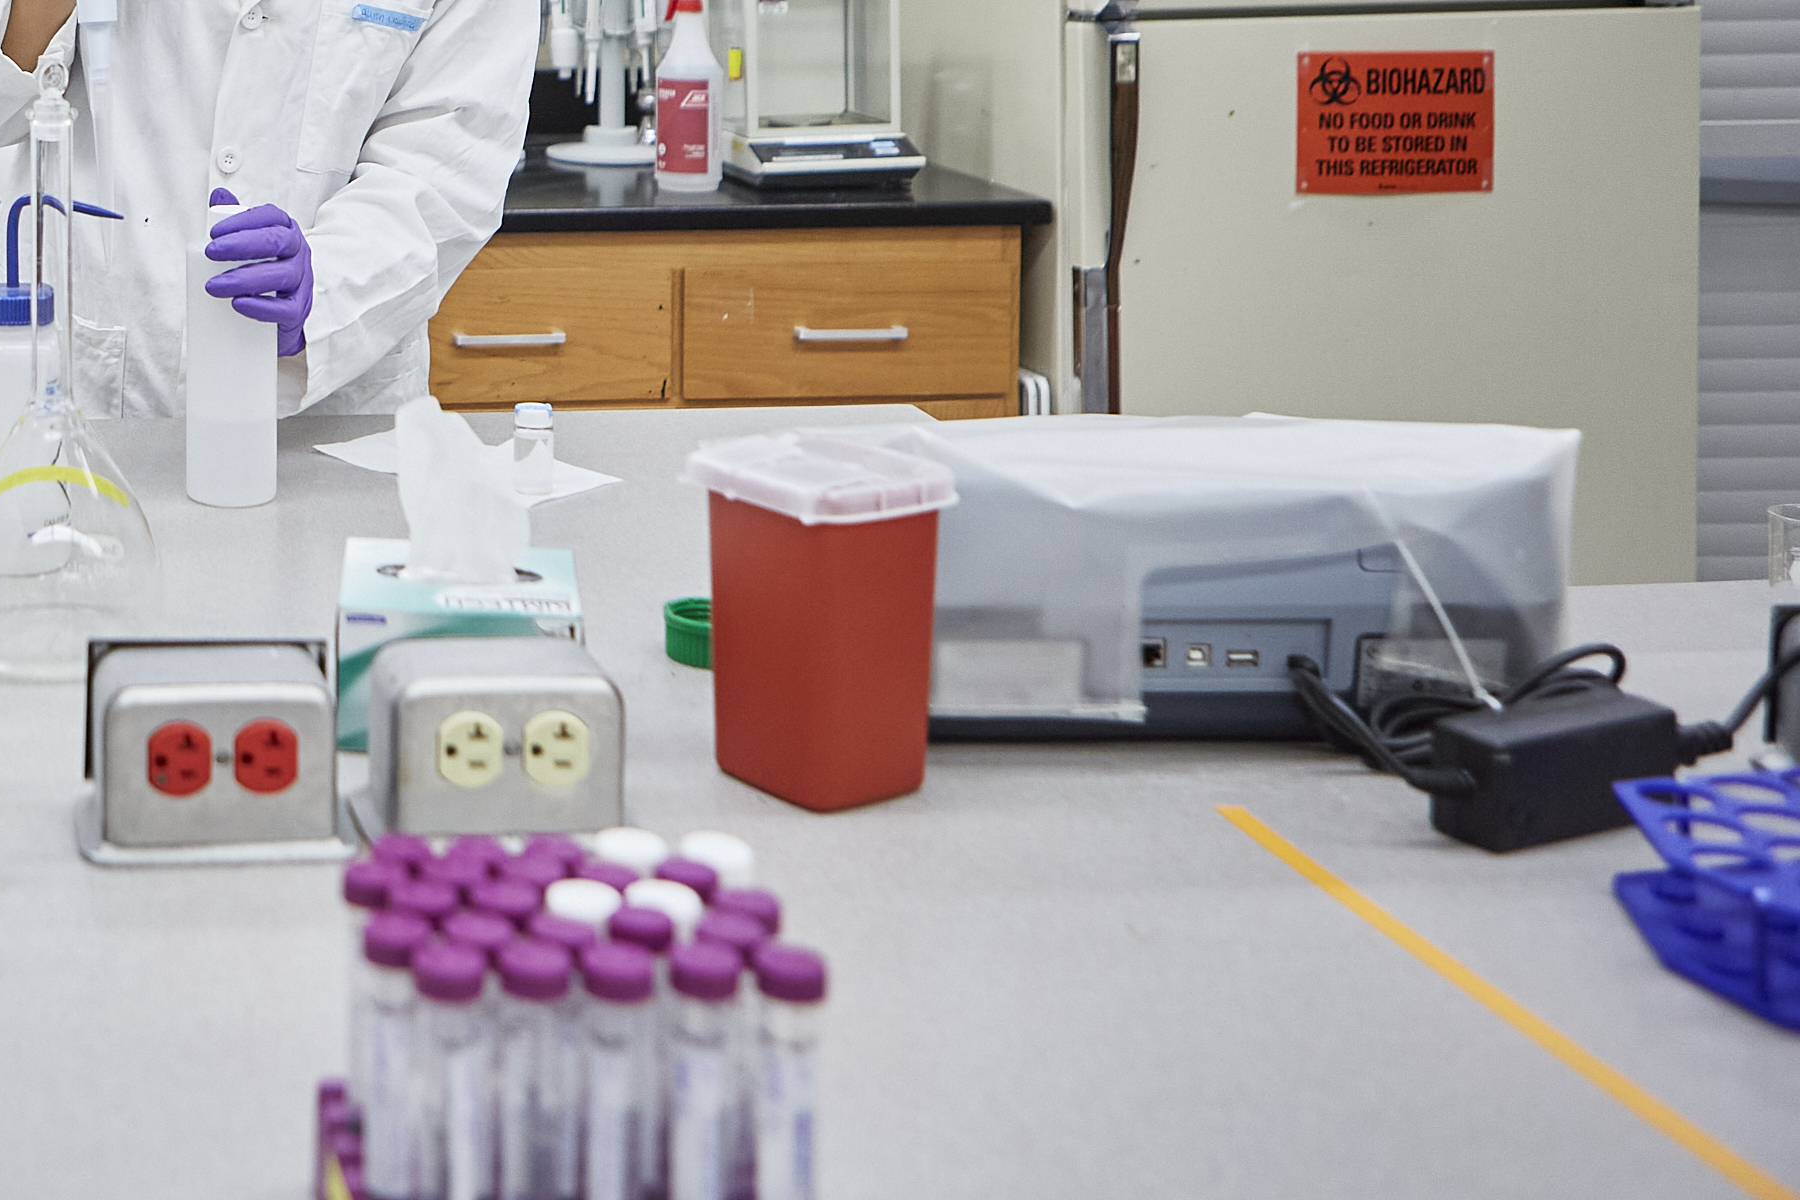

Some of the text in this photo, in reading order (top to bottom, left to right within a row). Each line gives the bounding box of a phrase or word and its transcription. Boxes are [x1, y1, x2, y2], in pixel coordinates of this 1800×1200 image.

[1365, 67, 1486, 95] BIOHAZARD
[1318, 111, 1476, 129] NO FOOD OR DRINK
[1327, 135, 1467, 152] TO BE STORED IN
[1315, 158, 1478, 176] THIS REFRIGERATOR
